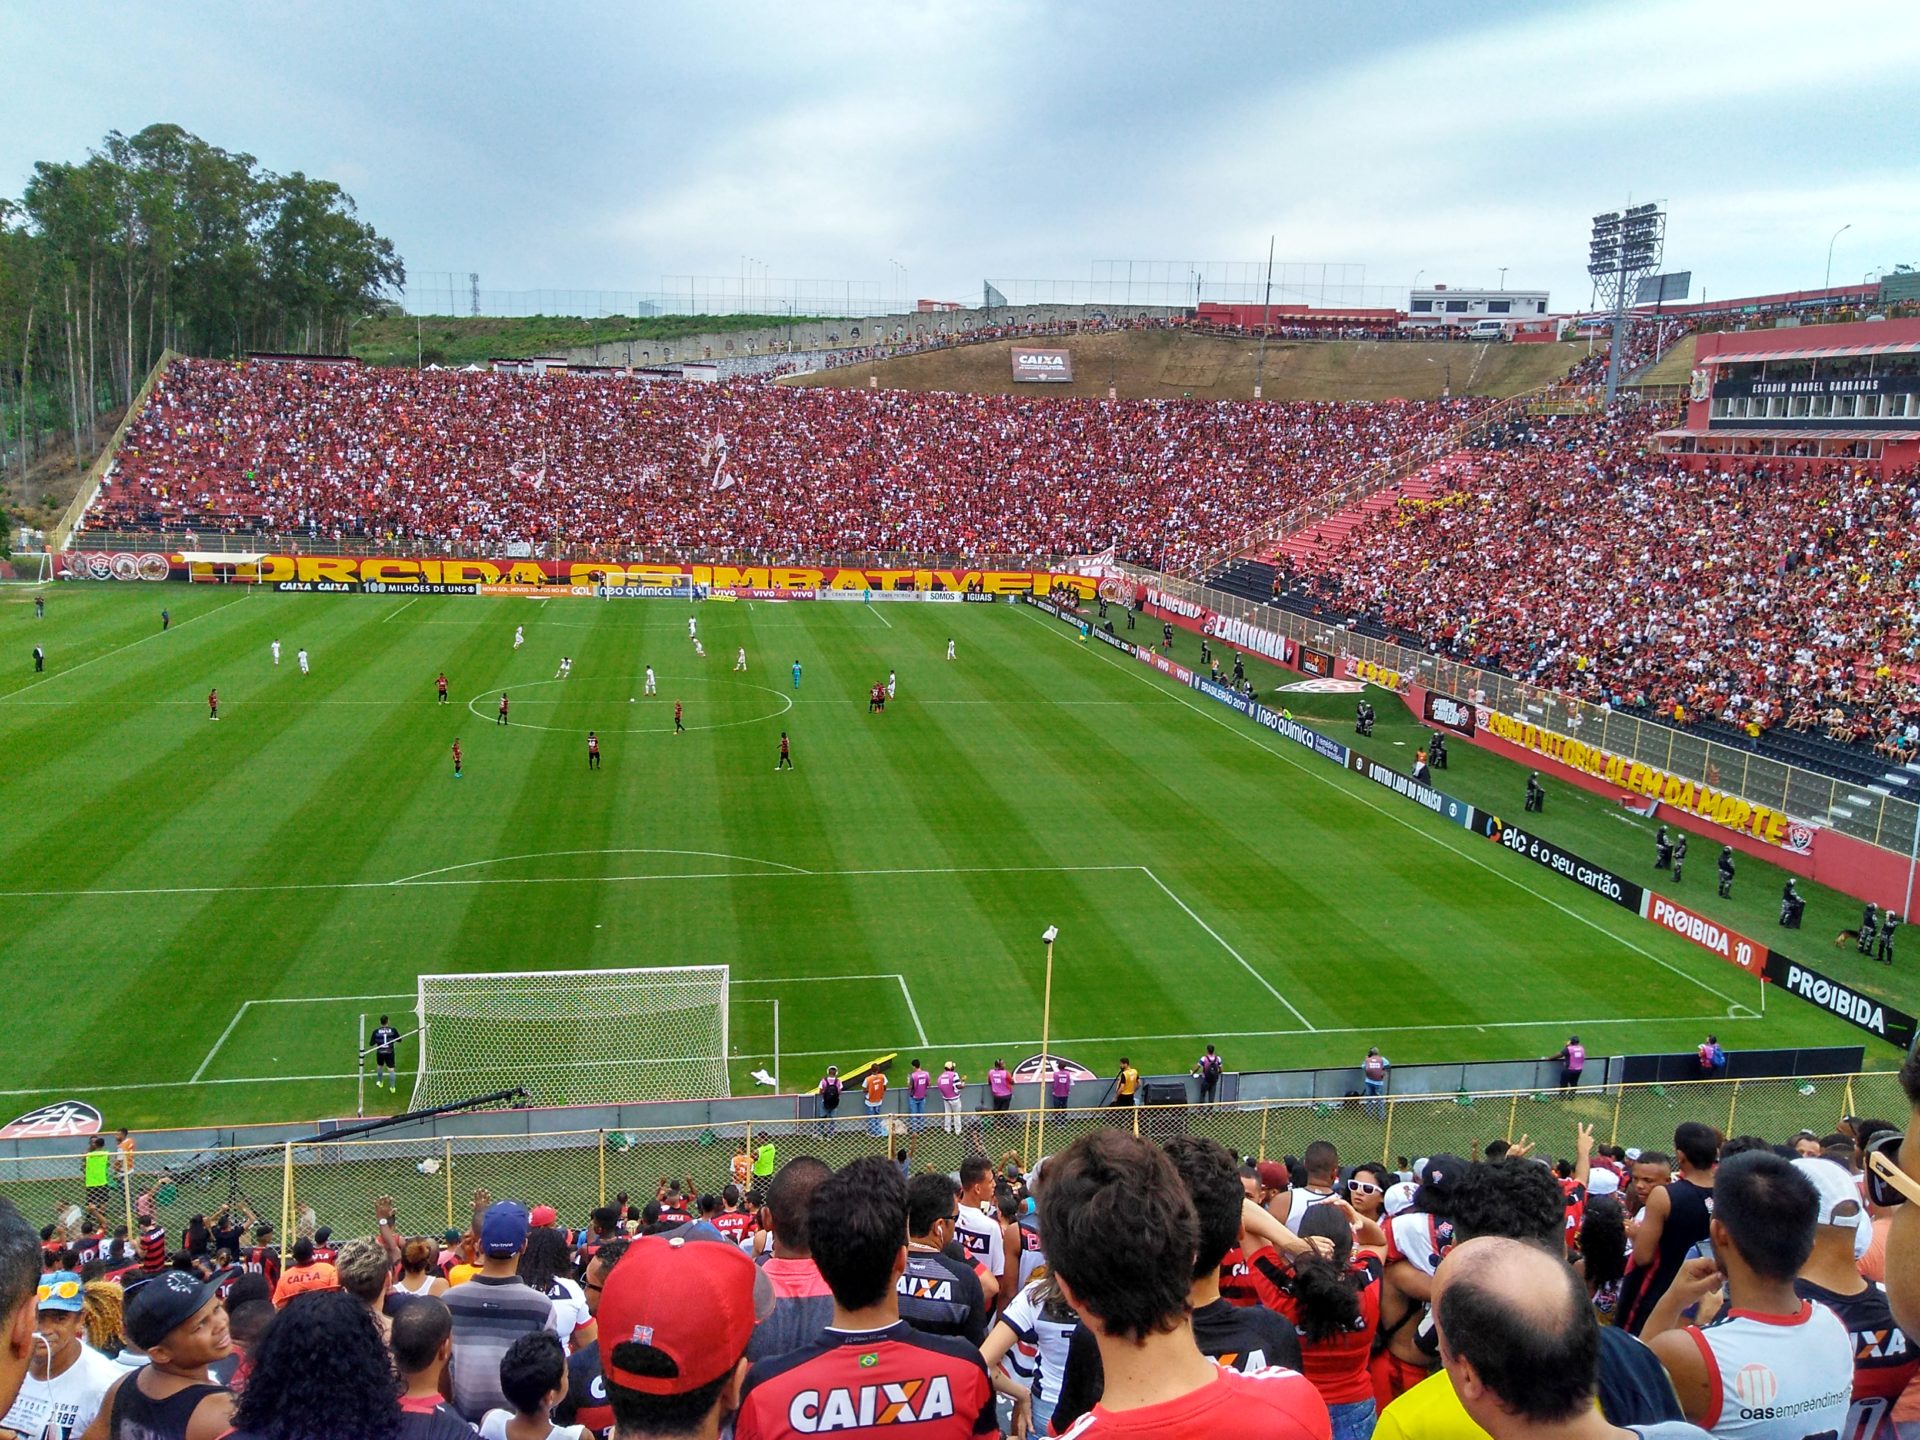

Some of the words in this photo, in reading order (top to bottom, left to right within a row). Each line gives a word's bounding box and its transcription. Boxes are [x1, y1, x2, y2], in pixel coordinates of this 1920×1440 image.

[1019, 355, 1063, 365] CAIXA
[1791, 382, 1824, 392] MANOEL
[1830, 380, 1879, 391] BARRADAS
[280, 583, 312, 591] CAIXA
[317, 583, 350, 591] CAIXA
[363, 582, 386, 593] 100
[388, 583, 430, 593] MILHÕES
[433, 585, 445, 593] DE
[447, 585, 466, 593] UNS
[571, 586, 592, 596] GOL
[600, 587, 624, 596] neo
[626, 585, 672, 598] química
[967, 593, 992, 602] IGUAIS
[1201, 681, 1233, 705] BRASILEIRÃO
[1233, 697, 1247, 712] 2017
[1260, 709, 1277, 729] neo
[1278, 719, 1313, 749] química
[1488, 711, 1524, 744] COM
[1524, 723, 1537, 750] O
[1604, 754, 1663, 799] ALEM
[1664, 775, 1695, 812] DA
[1697, 786, 1788, 847] MORTE
[1368, 762, 1374, 779] O
[1374, 765, 1393, 787] OUTRO
[1392, 773, 1408, 795] LADO
[1407, 780, 1416, 799] DO
[1415, 785, 1442, 812] PARAÍSO
[1503, 828, 1527, 852] elo
[1530, 841, 1539, 858] é
[1540, 849, 1550, 863] o
[1551, 853, 1575, 876] seu
[1577, 866, 1623, 901] cartão.
[718, 1218, 744, 1227] CAIXA
[953, 1231, 985, 1249] AIXA
[287, 1272, 321, 1285] CAIXA
[896, 1275, 952, 1301] AIXA
[789, 1375, 953, 1433] CAIXA
